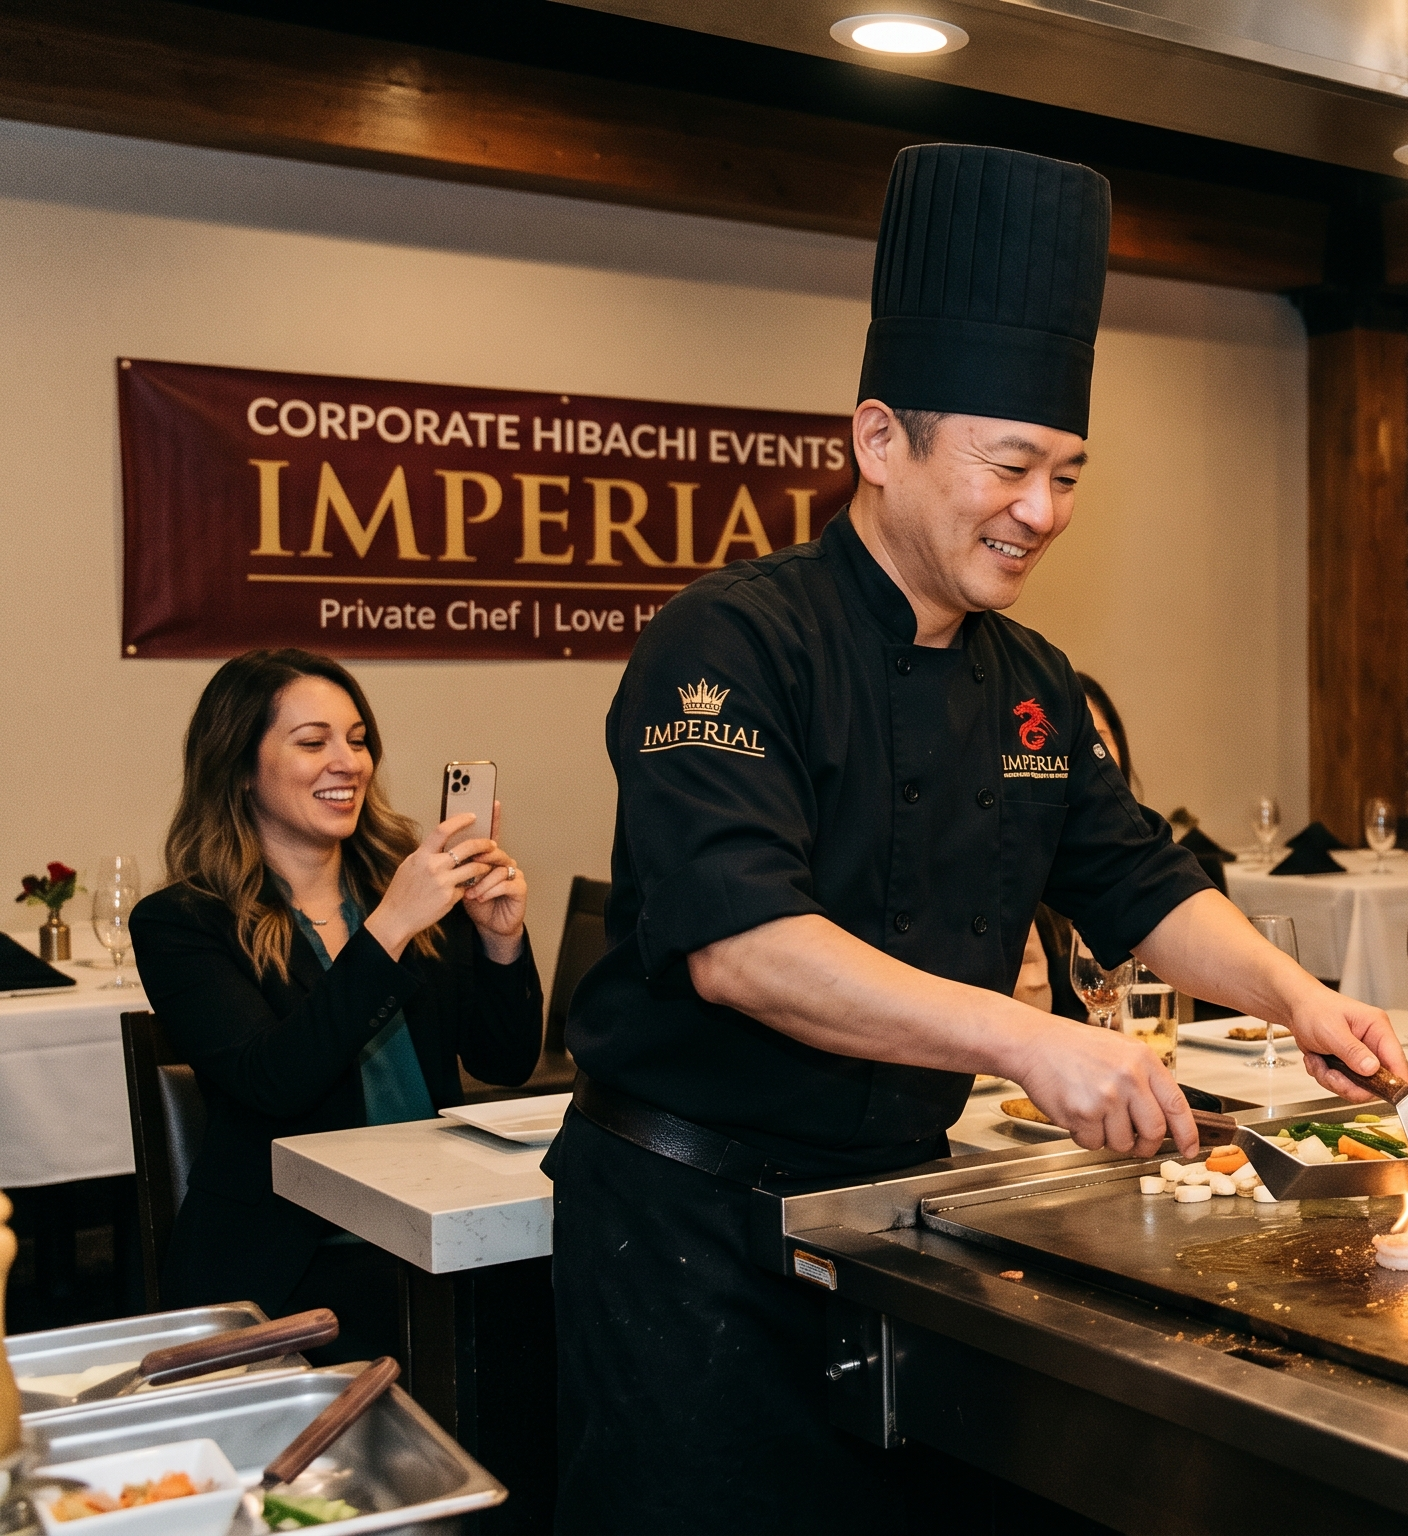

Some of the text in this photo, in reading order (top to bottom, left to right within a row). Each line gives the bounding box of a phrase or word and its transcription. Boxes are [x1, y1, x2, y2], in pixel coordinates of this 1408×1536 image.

[247, 397, 845, 471] CORPORATE HIBACHI EVENTS
[319, 598, 436, 630] Private
[449, 600, 522, 631] Chef
[555, 603, 625, 632] Love
[643, 719, 765, 752] IMPERIAL
